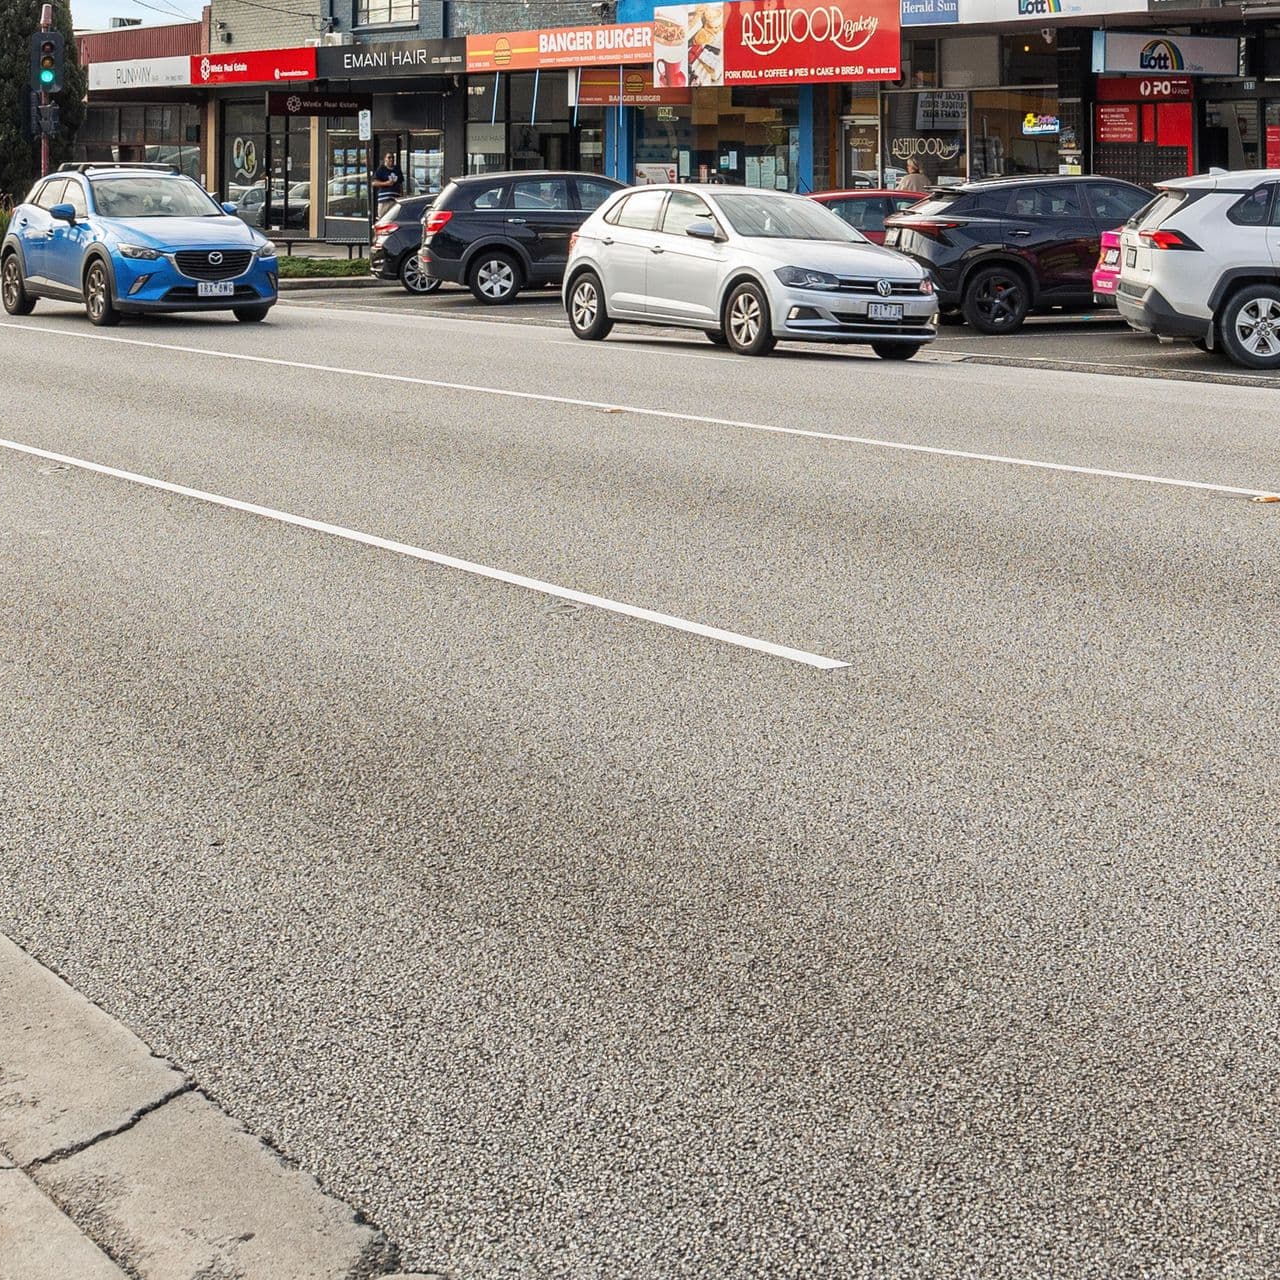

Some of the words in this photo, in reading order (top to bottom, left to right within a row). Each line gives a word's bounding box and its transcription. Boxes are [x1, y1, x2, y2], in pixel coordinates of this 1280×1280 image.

[902, 1, 934, 13] Herald
[937, 0, 957, 11] Sun
[740, 5, 845, 55] ASHWOOD
[843, 15, 879, 43] Bakery
[539, 31, 593, 54] BANGER
[596, 27, 652, 49] BURGER
[343, 52, 386, 69] EMANI
[392, 49, 427, 66] HAIR
[1140, 52, 1169, 69] Lott
[116, 67, 152, 85] RUNWAY
[725, 70, 741, 79] PORK
[742, 69, 757, 78] ROLL
[764, 68, 788, 78] COFFEE
[794, 67, 809, 77] PIES
[816, 66, 834, 76] CAKE
[841, 66, 864, 75] BREAD
[1152, 80, 1171, 95] PO
[891, 137, 944, 160] ASHWOOD
